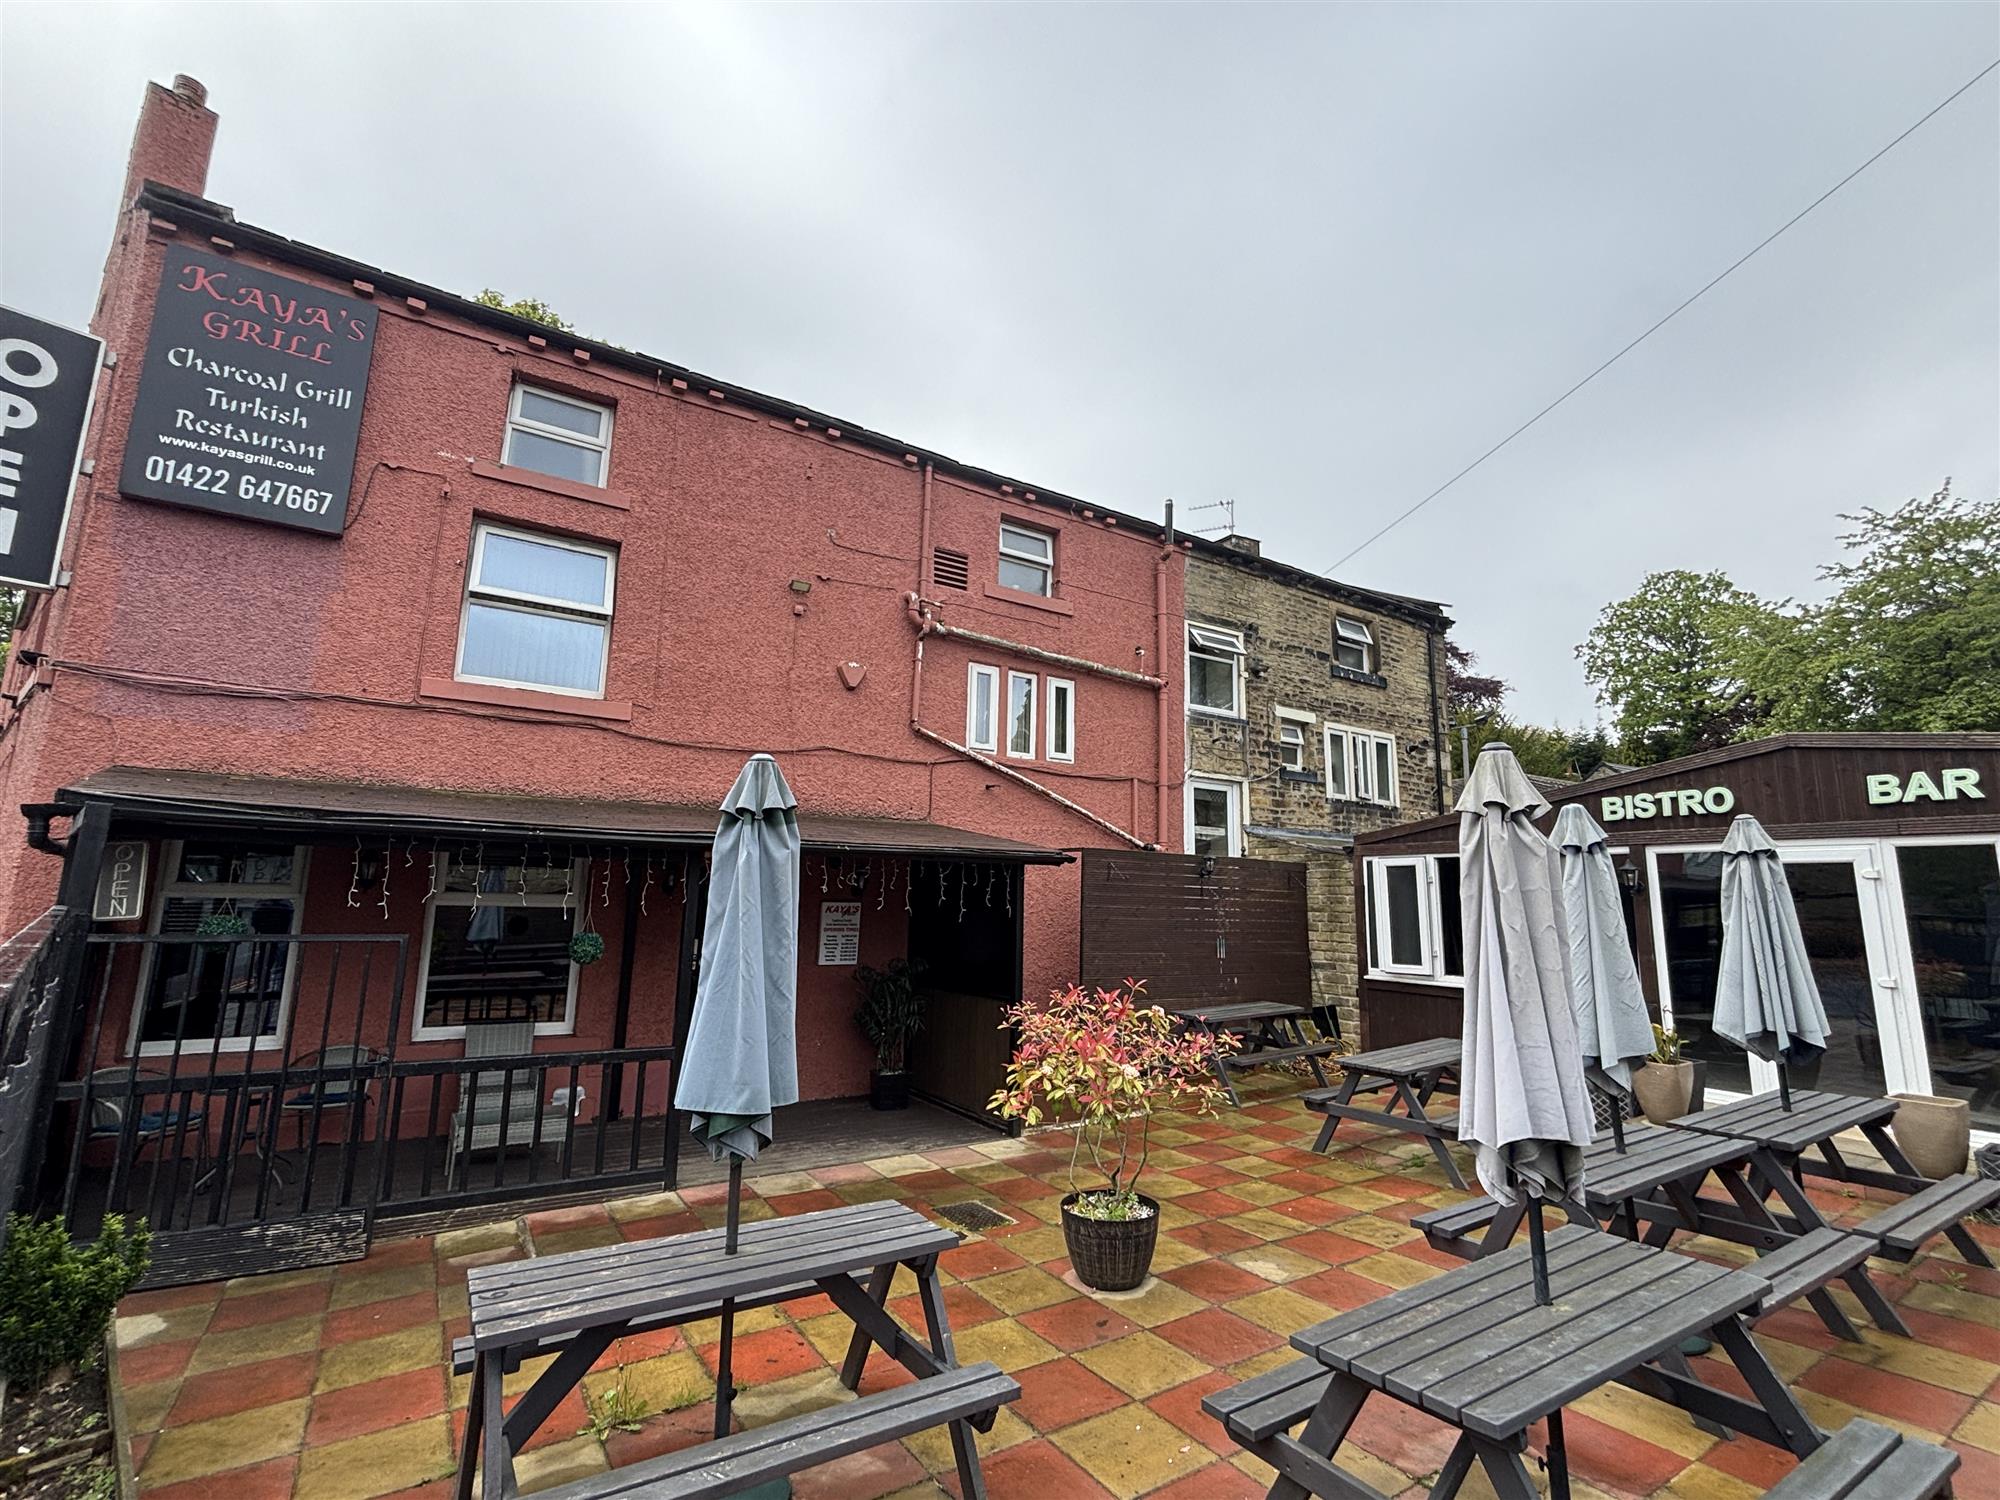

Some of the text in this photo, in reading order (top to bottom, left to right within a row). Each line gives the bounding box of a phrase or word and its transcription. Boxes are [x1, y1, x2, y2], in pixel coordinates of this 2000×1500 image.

[177, 265, 367, 342] KAYA'S
[203, 311, 333, 365] GRILL
[167, 347, 352, 410] Charcoal Grill
[175, 408, 326, 461] Restaurant
[205, 387, 308, 429] Turkish
[158, 434, 316, 476] www.kayasgrill.co.uk
[145, 455, 333, 515] 01422 647667
[1601, 767, 1986, 822] BISTRO BAR
[109, 845, 134, 917] OPEN
